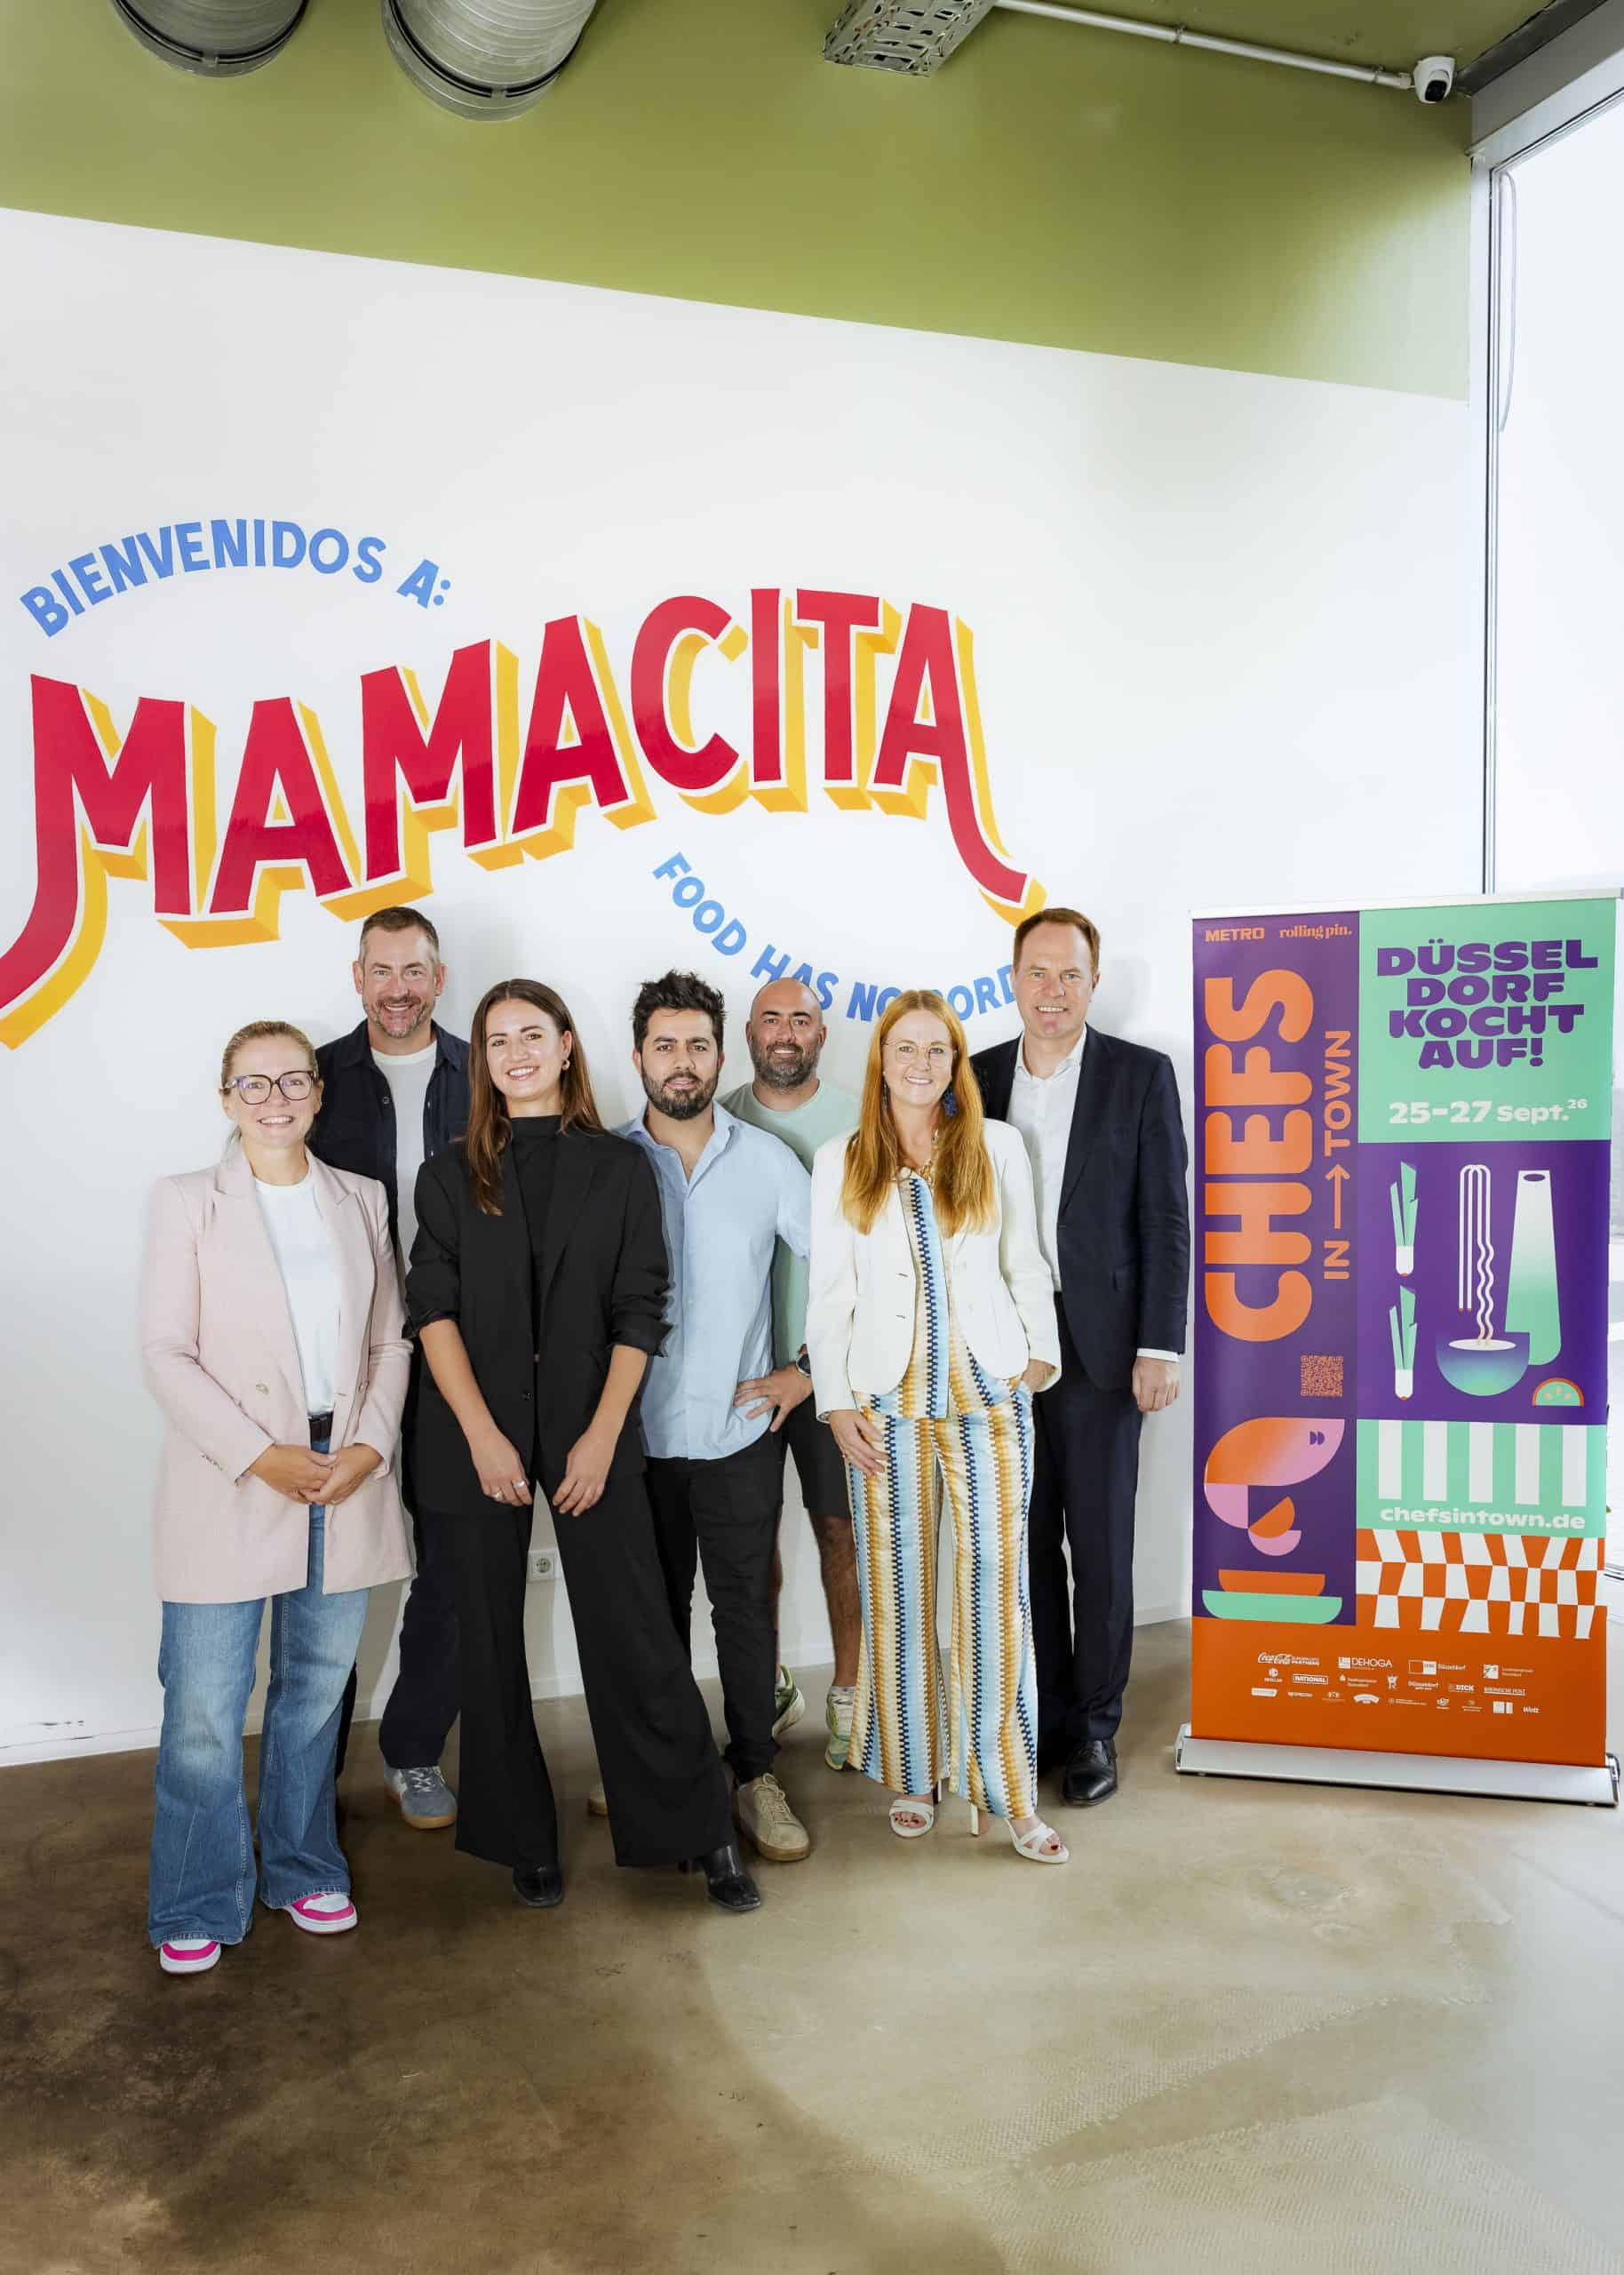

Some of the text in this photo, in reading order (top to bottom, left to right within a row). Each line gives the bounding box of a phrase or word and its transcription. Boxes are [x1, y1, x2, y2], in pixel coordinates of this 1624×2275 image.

[20, 518, 452, 637] BIENVENIDOS A:
[0, 587, 1043, 1031] MAMACITA
[652, 851, 747, 956] FOOD
[750, 944, 840, 1010] HAS
[1205, 923, 1352, 942] METRO rolling pin.
[1377, 938, 1598, 977] DÜSSEL
[1406, 972, 1565, 1007] DORF
[1389, 1004, 1585, 1039] KOCHT
[1419, 1037, 1543, 1069] AUF!
[1205, 969, 1314, 1342] CHEFS
[1324, 1030, 1351, 1280] IN TOWN
[1379, 1506, 1586, 1529] chefsintown.de
[1351, 1656, 1393, 1668] DEHOGA
